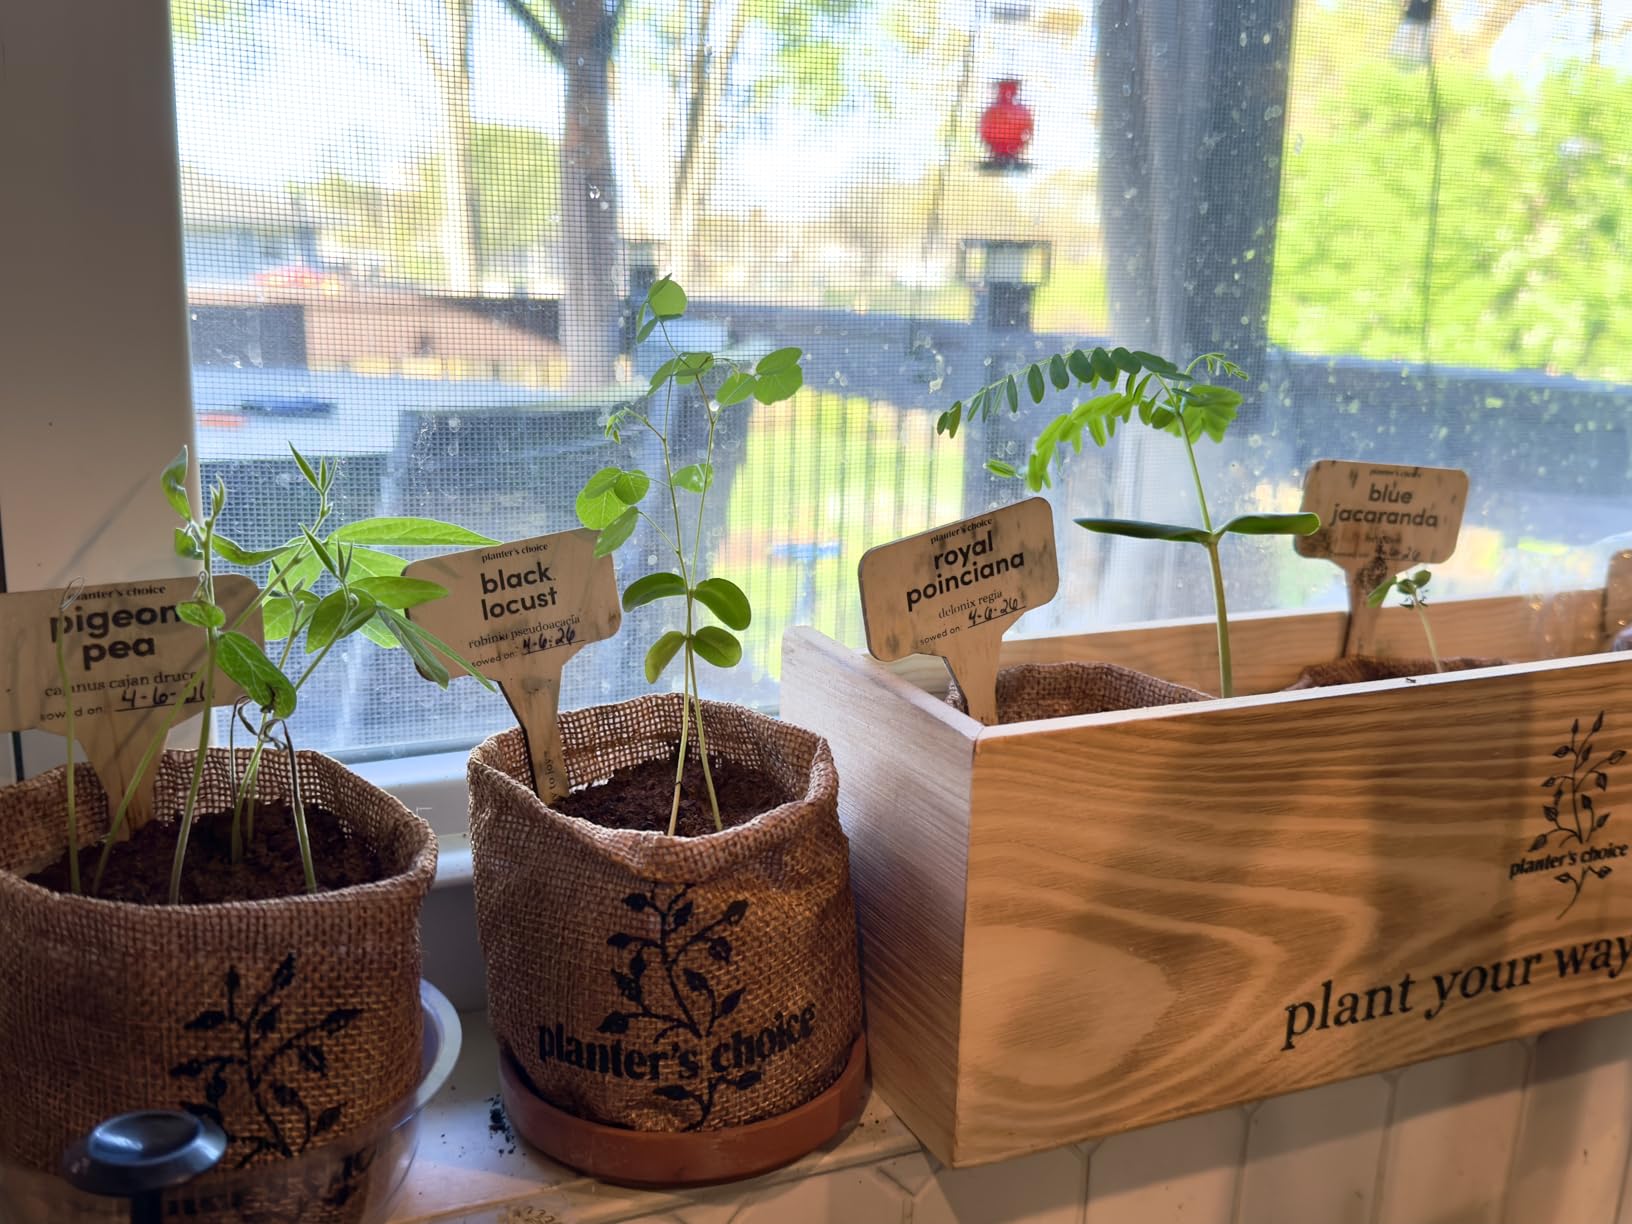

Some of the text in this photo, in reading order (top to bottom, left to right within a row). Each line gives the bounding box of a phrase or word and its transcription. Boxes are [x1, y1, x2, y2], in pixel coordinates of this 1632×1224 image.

[1368, 482, 1414, 504] blue
[967, 518, 993, 532] choice
[1330, 503, 1439, 528] jacaranda
[481, 543, 548, 564] planter's choice
[933, 531, 994, 570] royal
[480, 561, 552, 595] black
[906, 551, 1025, 612] poinciana
[481, 586, 558, 621] locust
[920, 630, 948, 645] sowed
[82, 637, 155, 670] pea
[471, 654, 501, 667] sowed
[109, 674, 150, 690] cajan
[40, 707, 83, 721] sowd
[1508, 842, 1629, 880] planter's choice
[1281, 936, 1632, 1051] plant your way
[538, 1002, 817, 1081] planter's choice
